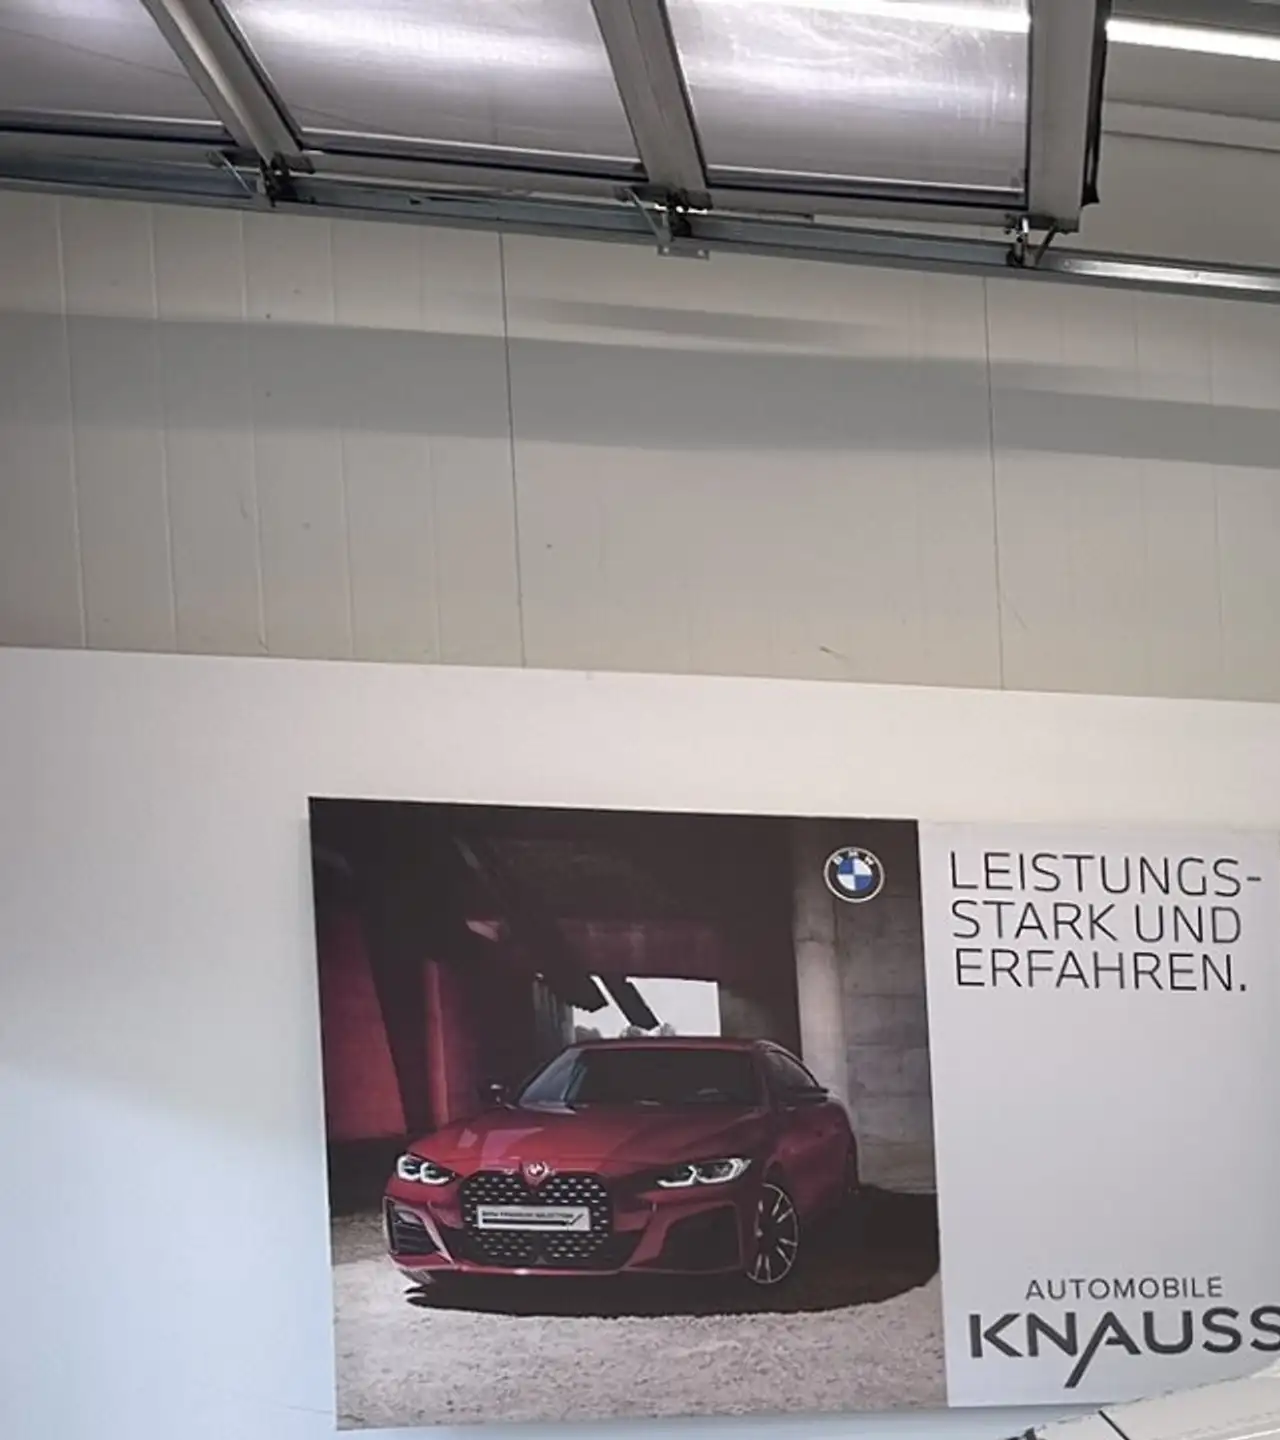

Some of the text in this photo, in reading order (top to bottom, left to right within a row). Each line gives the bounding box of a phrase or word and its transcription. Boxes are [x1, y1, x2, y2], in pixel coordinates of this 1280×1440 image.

[951, 851, 1261, 897] LEISTUNGS-
[951, 900, 1241, 945] STARK UND
[956, 947, 1247, 992] ERFAHREN.
[1026, 1276, 1223, 1299] AUTOMOBILE
